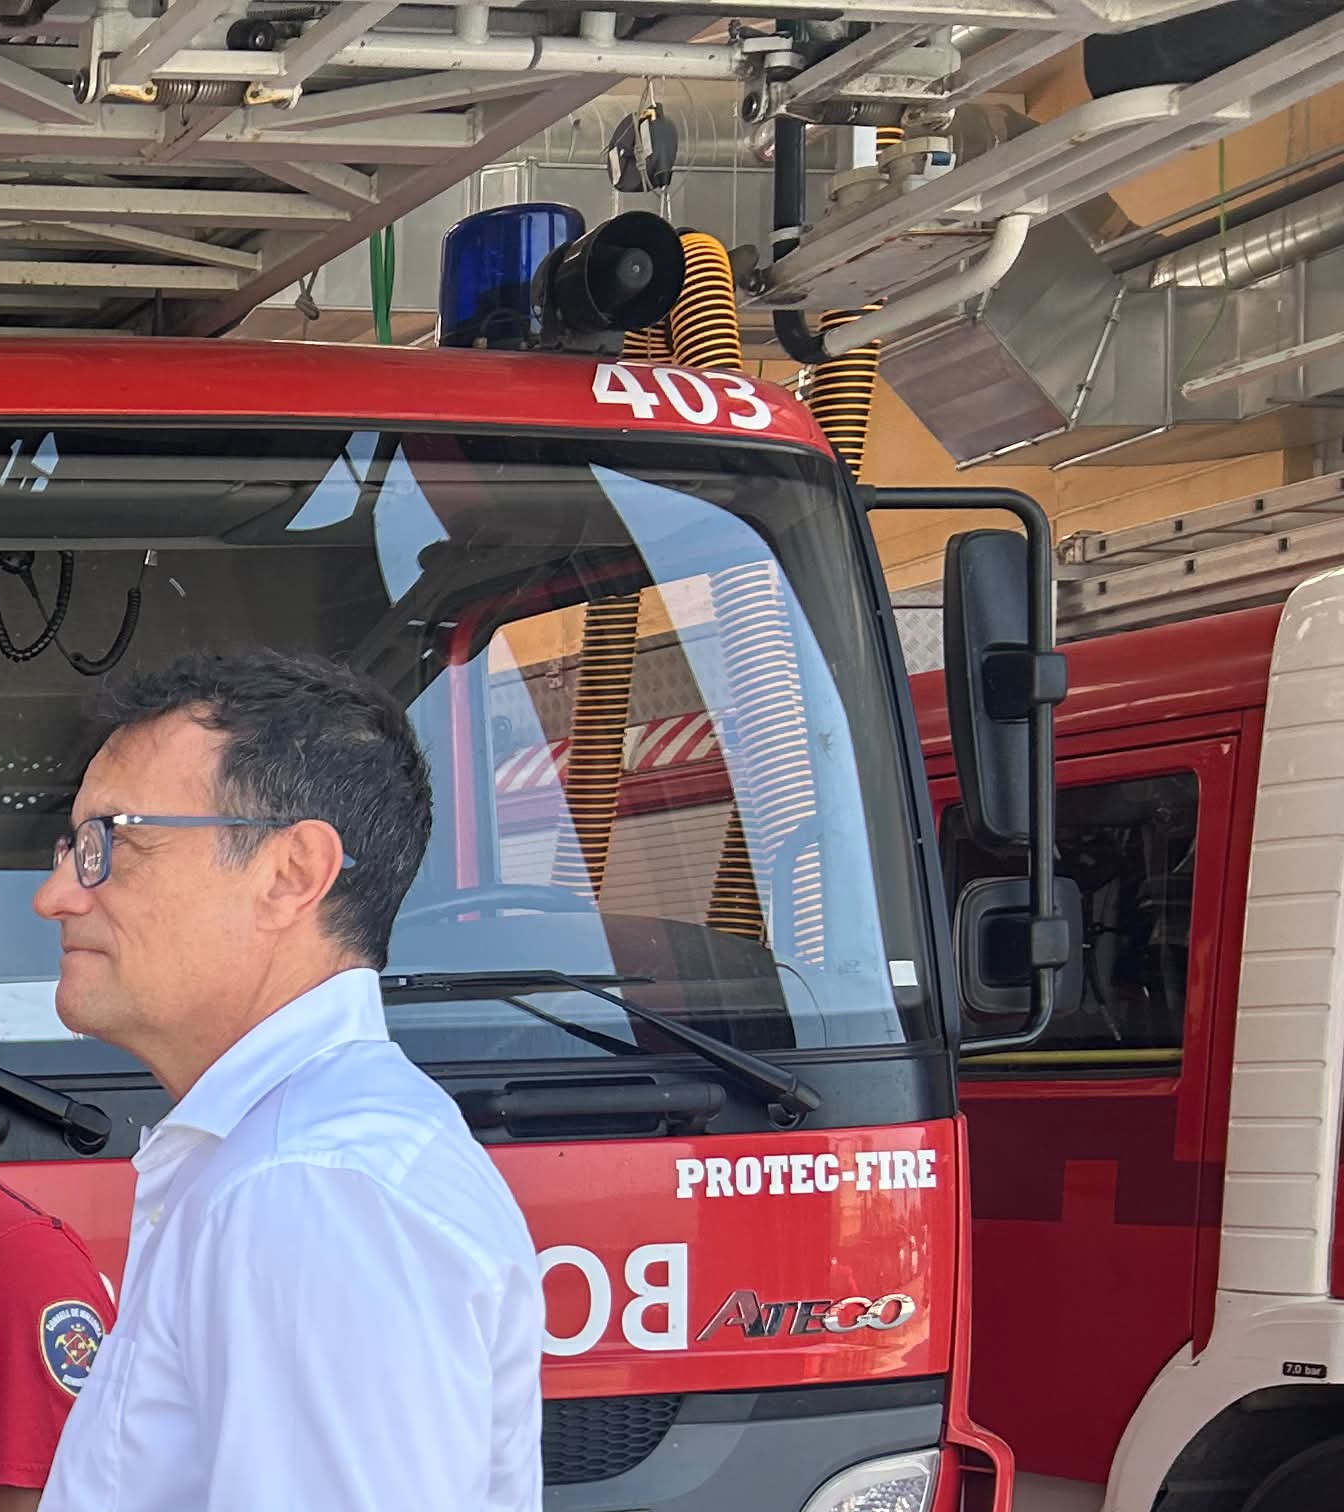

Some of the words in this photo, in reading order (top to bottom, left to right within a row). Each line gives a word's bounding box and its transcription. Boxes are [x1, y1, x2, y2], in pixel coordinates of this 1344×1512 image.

[591, 363, 772, 430] 403
[675, 1149, 937, 1199] PROTEC-FIRE
[696, 1288, 916, 1342] ATEGO
